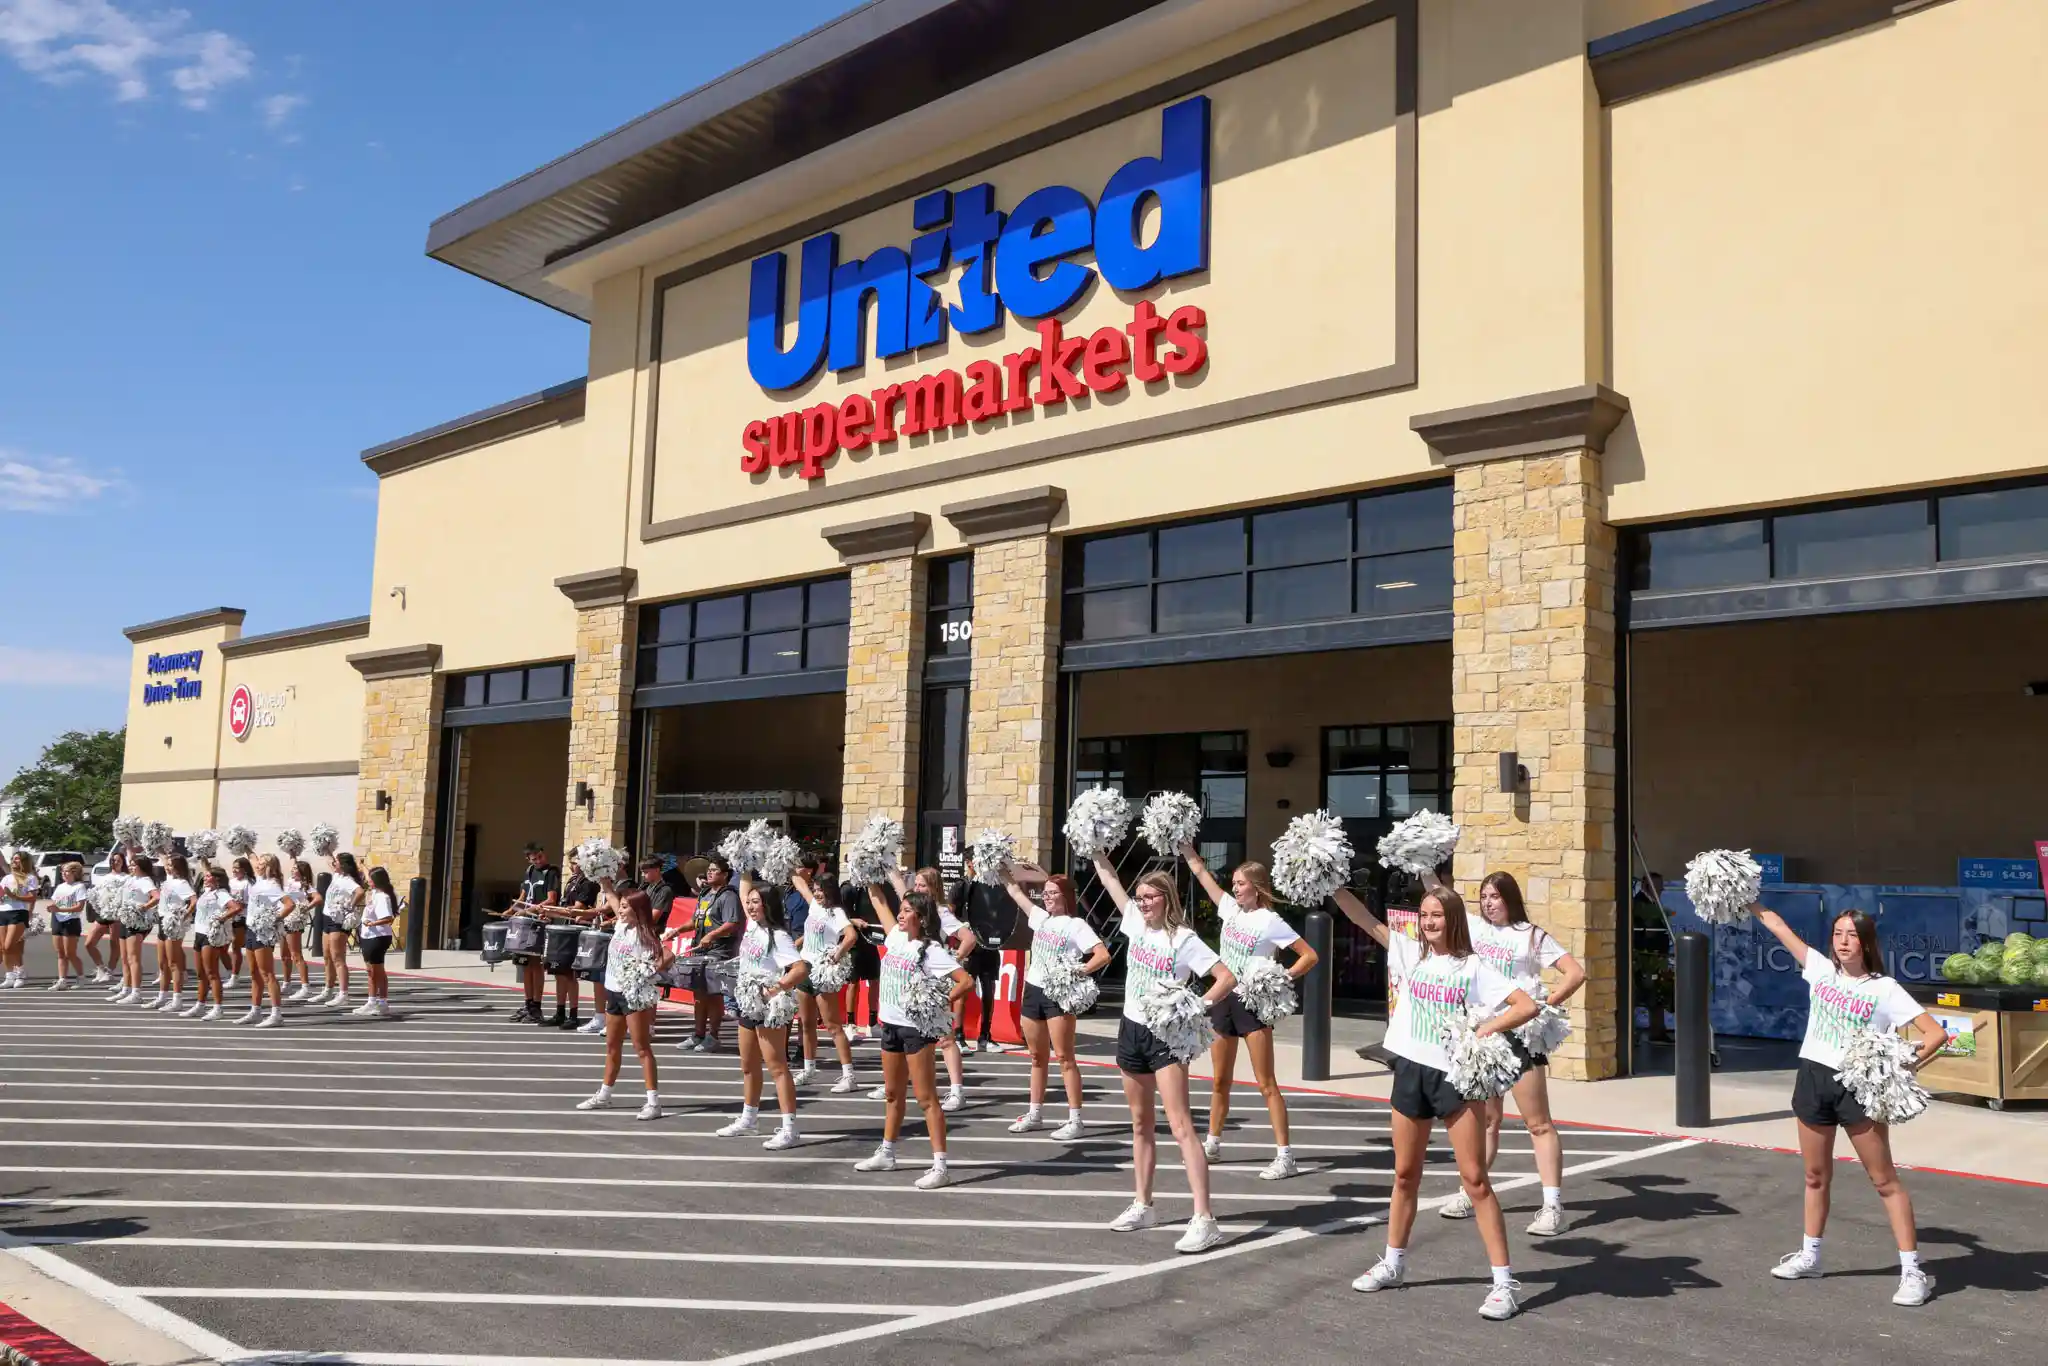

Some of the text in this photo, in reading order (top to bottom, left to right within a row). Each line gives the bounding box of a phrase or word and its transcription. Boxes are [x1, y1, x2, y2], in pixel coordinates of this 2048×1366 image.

[747, 95, 1211, 389] United
[741, 300, 1208, 479] supermarkets
[940, 620, 972, 642] 150
[147, 649, 203, 675] Pharmacy
[143, 677, 202, 705] Drive-Thru
[1757, 944, 1805, 973] IC
[1408, 979, 1466, 1005] NDREWS
